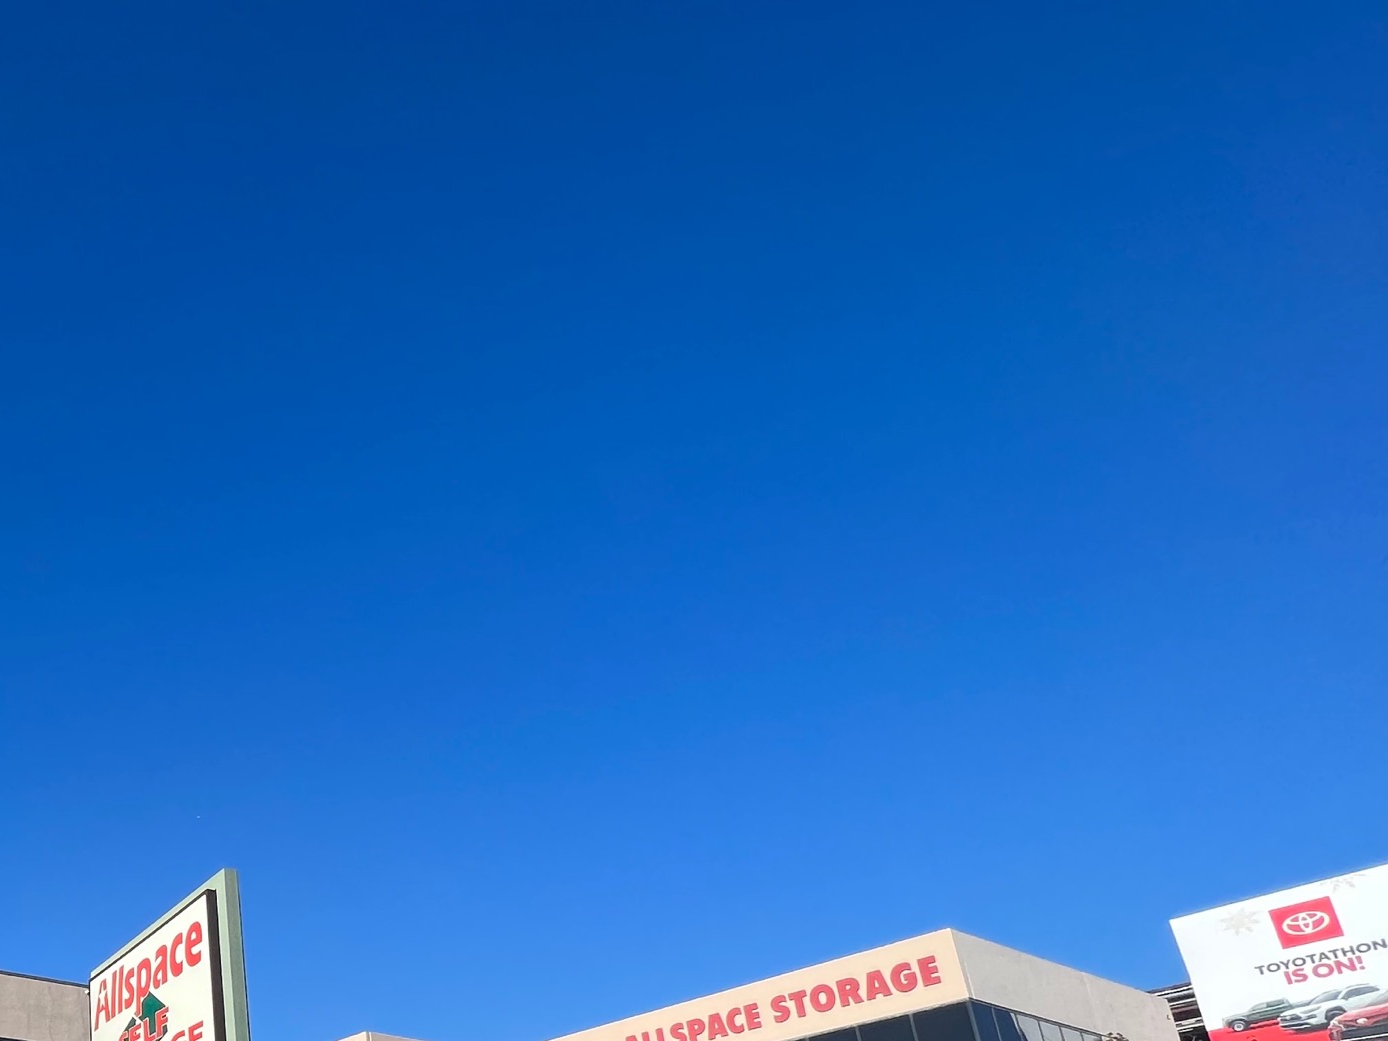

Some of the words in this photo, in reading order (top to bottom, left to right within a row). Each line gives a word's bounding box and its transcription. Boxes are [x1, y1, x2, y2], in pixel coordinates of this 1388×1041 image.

[94, 921, 203, 1032] Allspace
[1254, 938, 1388, 975] TOYOTATHON
[1284, 967, 1309, 985] IS
[1312, 955, 1366, 978] ON!
[771, 955, 942, 1024] STORAGE
